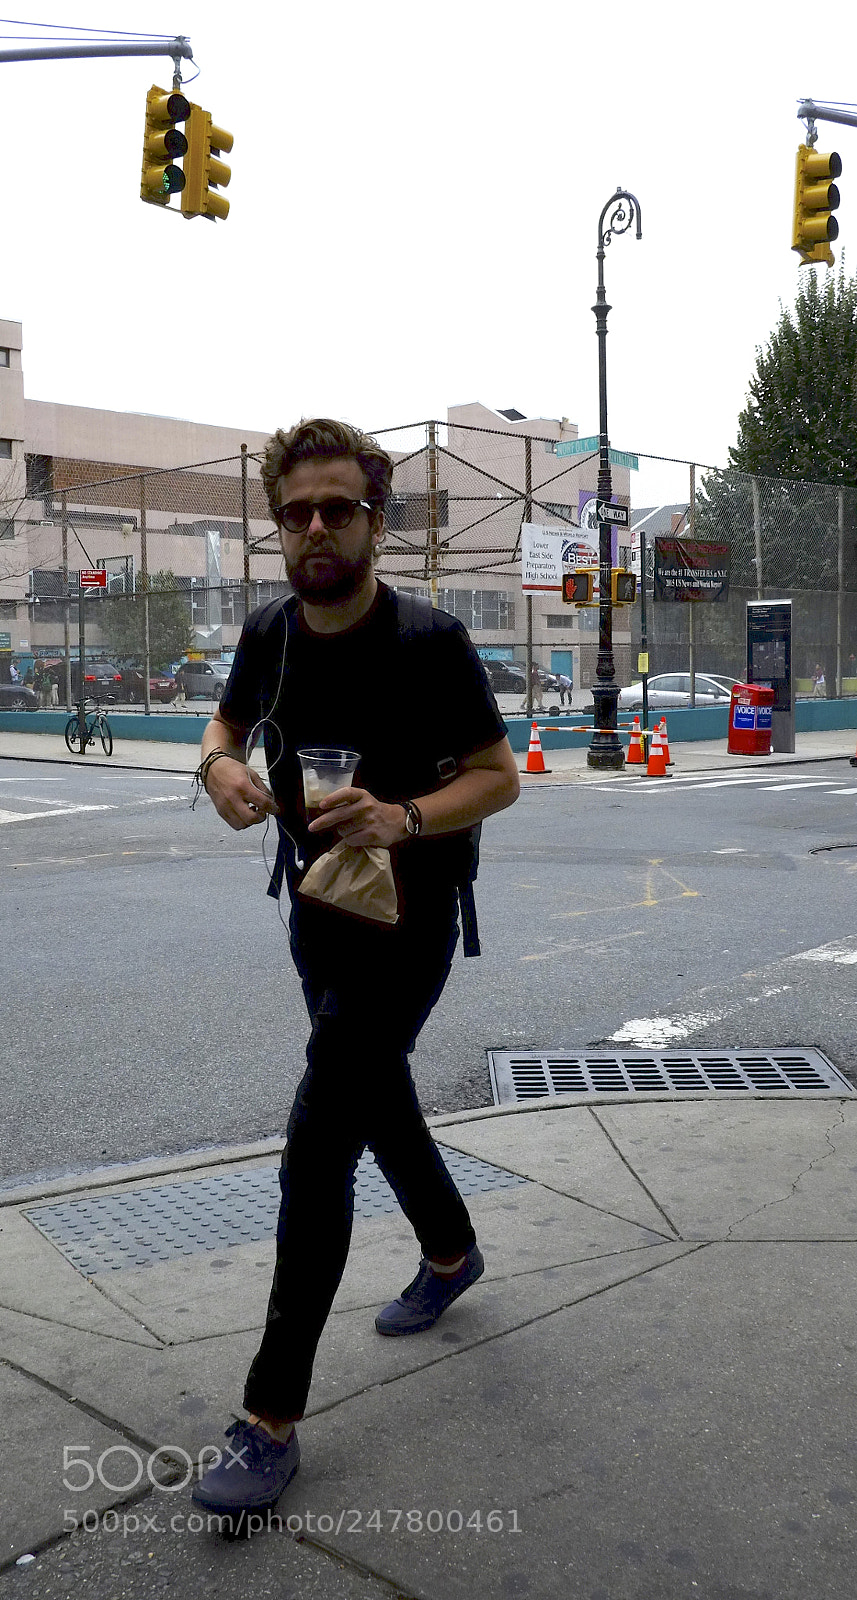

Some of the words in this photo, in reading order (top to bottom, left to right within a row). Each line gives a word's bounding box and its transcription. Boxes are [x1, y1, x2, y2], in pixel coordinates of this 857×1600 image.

[557, 440, 589, 456] NORFOLK
[601, 508, 609, 517] ONE
[613, 511, 625, 520] WAY
[533, 541, 549, 549] Lower
[529, 551, 541, 559] East
[542, 551, 553, 559] Side
[568, 552, 594, 565] BEST
[526, 561, 556, 571] Preparatory
[525, 572, 539, 580] High
[540, 572, 558, 580] School
[682, 579, 692, 588] News
[700, 580, 711, 588] World
[737, 706, 755, 715] VOICE
[758, 706, 772, 715] VOICE
